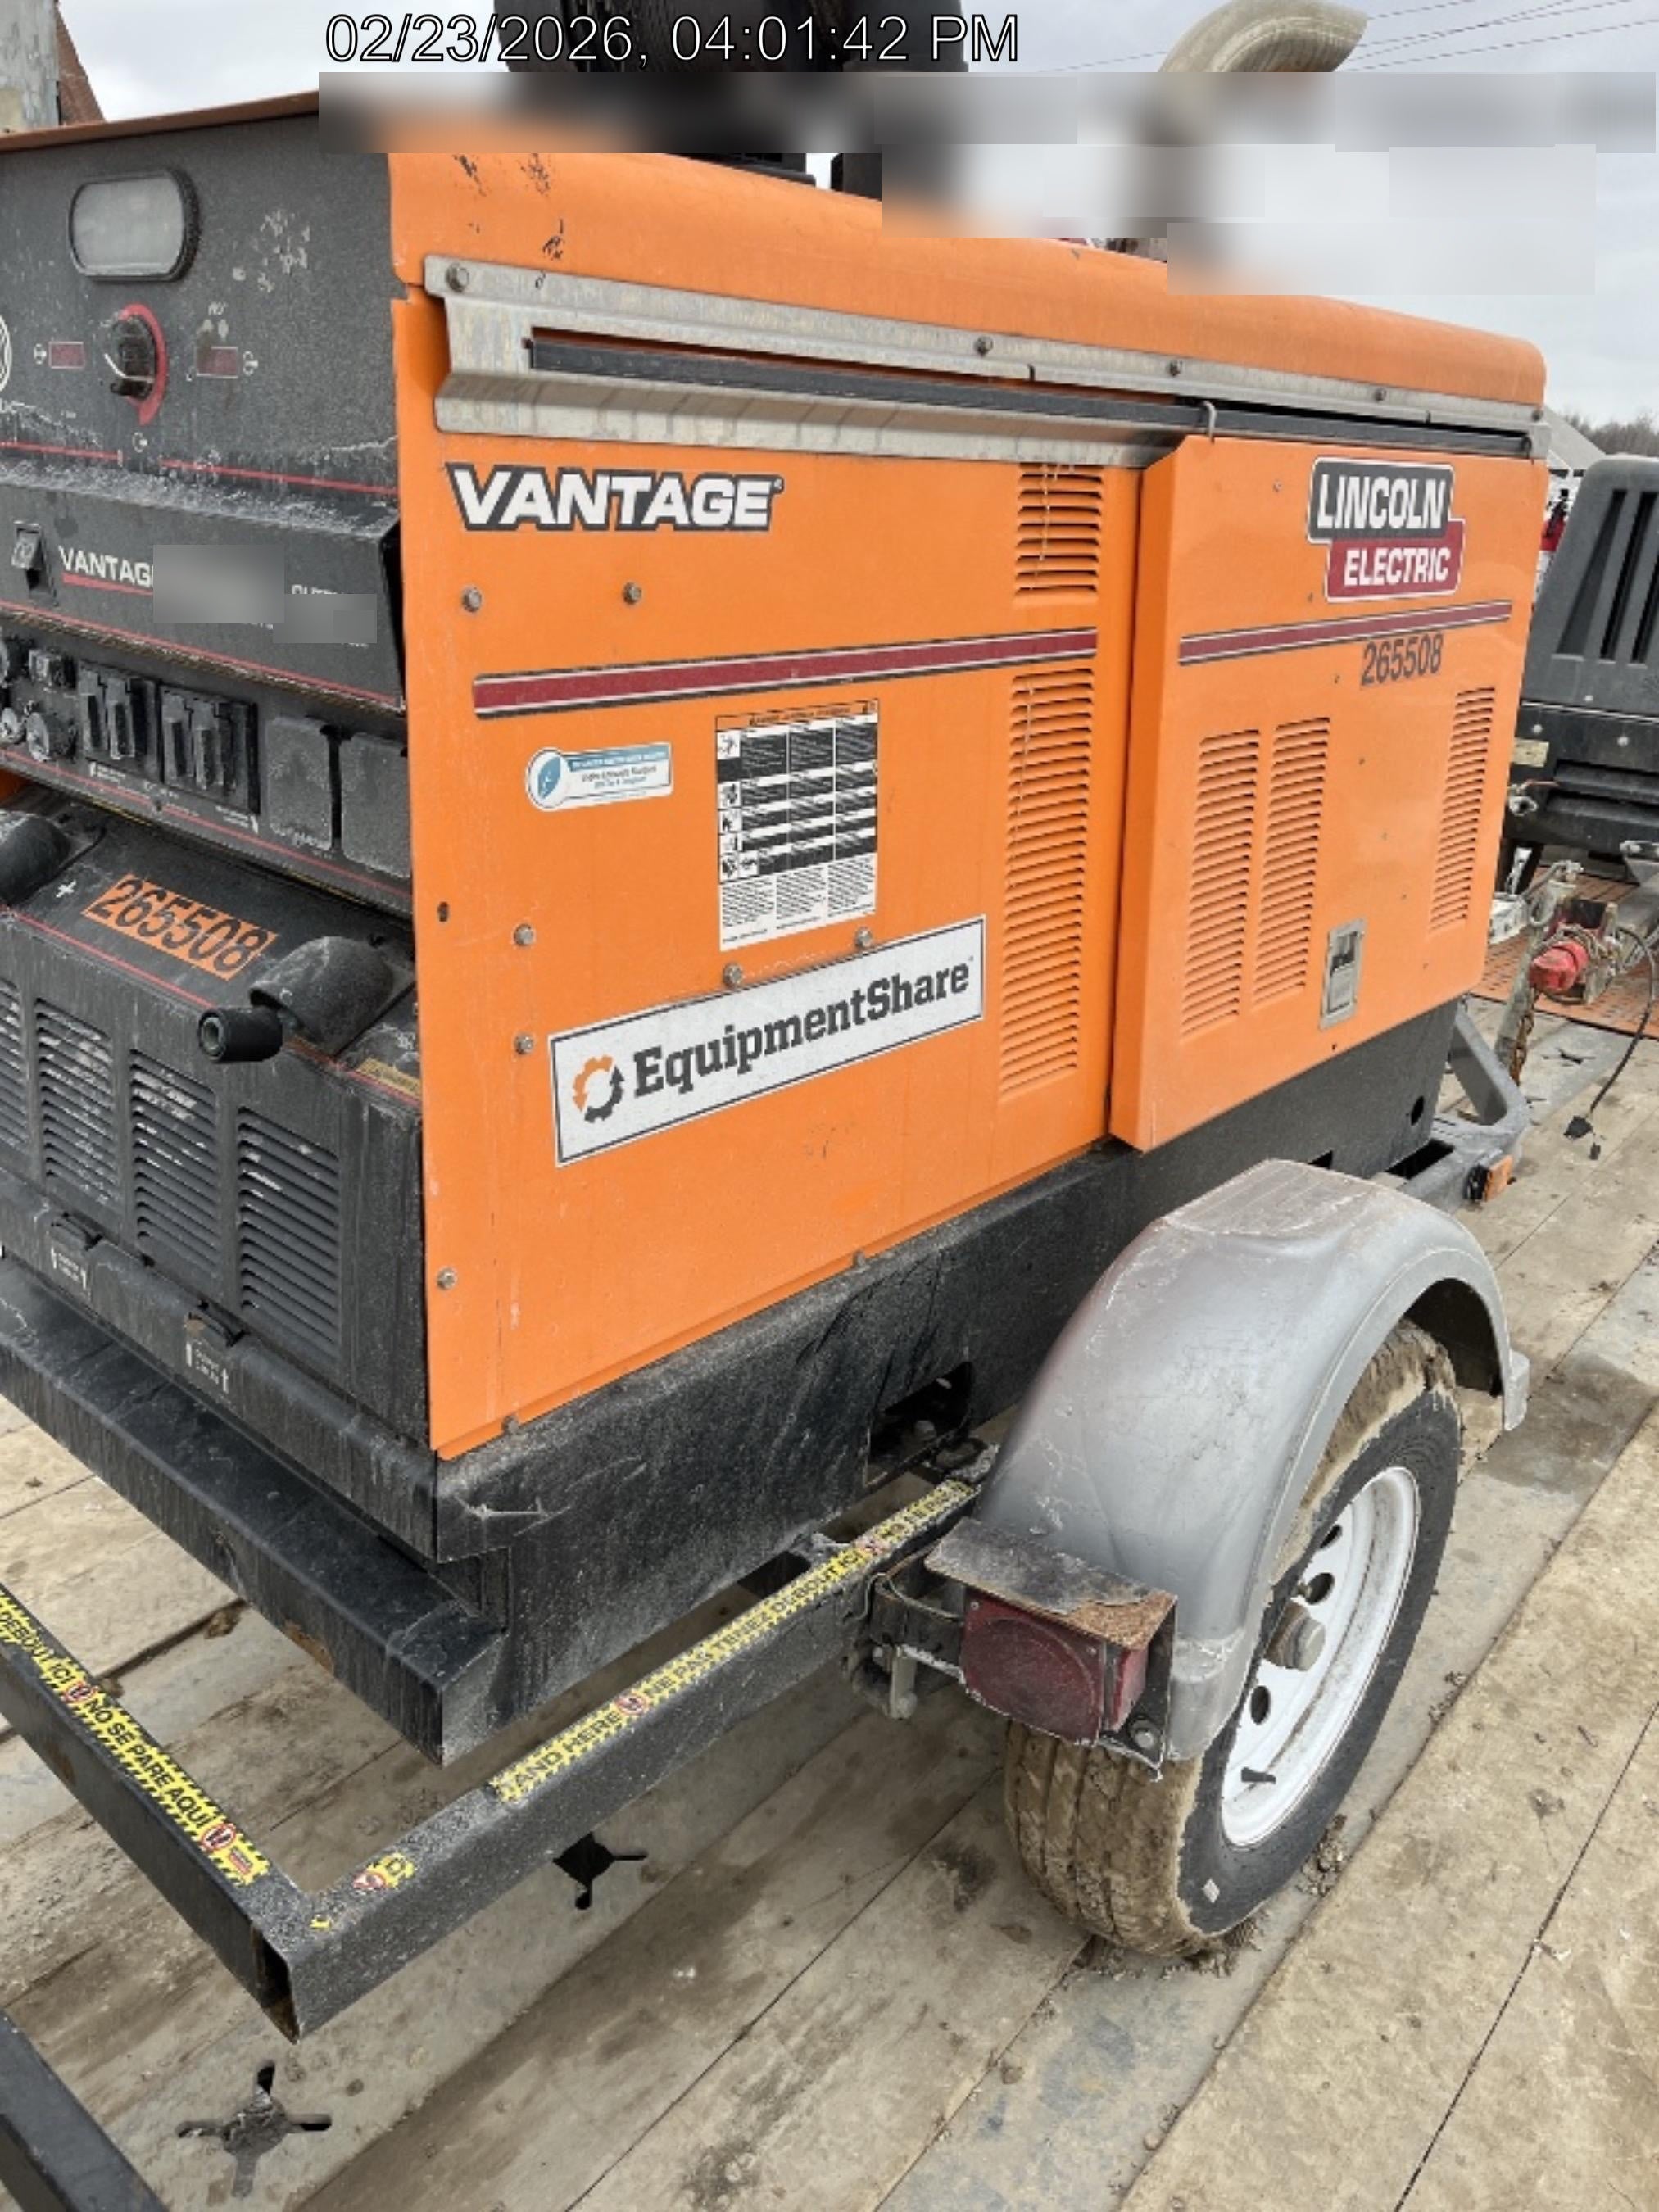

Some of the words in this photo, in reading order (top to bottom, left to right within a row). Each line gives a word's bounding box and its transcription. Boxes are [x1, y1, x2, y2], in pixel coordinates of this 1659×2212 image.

[446, 461, 784, 531] VANTAGE
[1316, 474, 1446, 529] LINCOLN
[58, 545, 154, 587] VANTAG
[1344, 547, 1451, 587] ELECTRIC
[1361, 632, 1444, 686] 265508
[88, 878, 269, 972] 265508
[633, 960, 970, 1099] EquipmentShare
[83, 1698, 114, 1724] NO
[107, 1722, 136, 1745] SE
[125, 1744, 175, 1788] PARE
[562, 1709, 621, 1752] HERE
